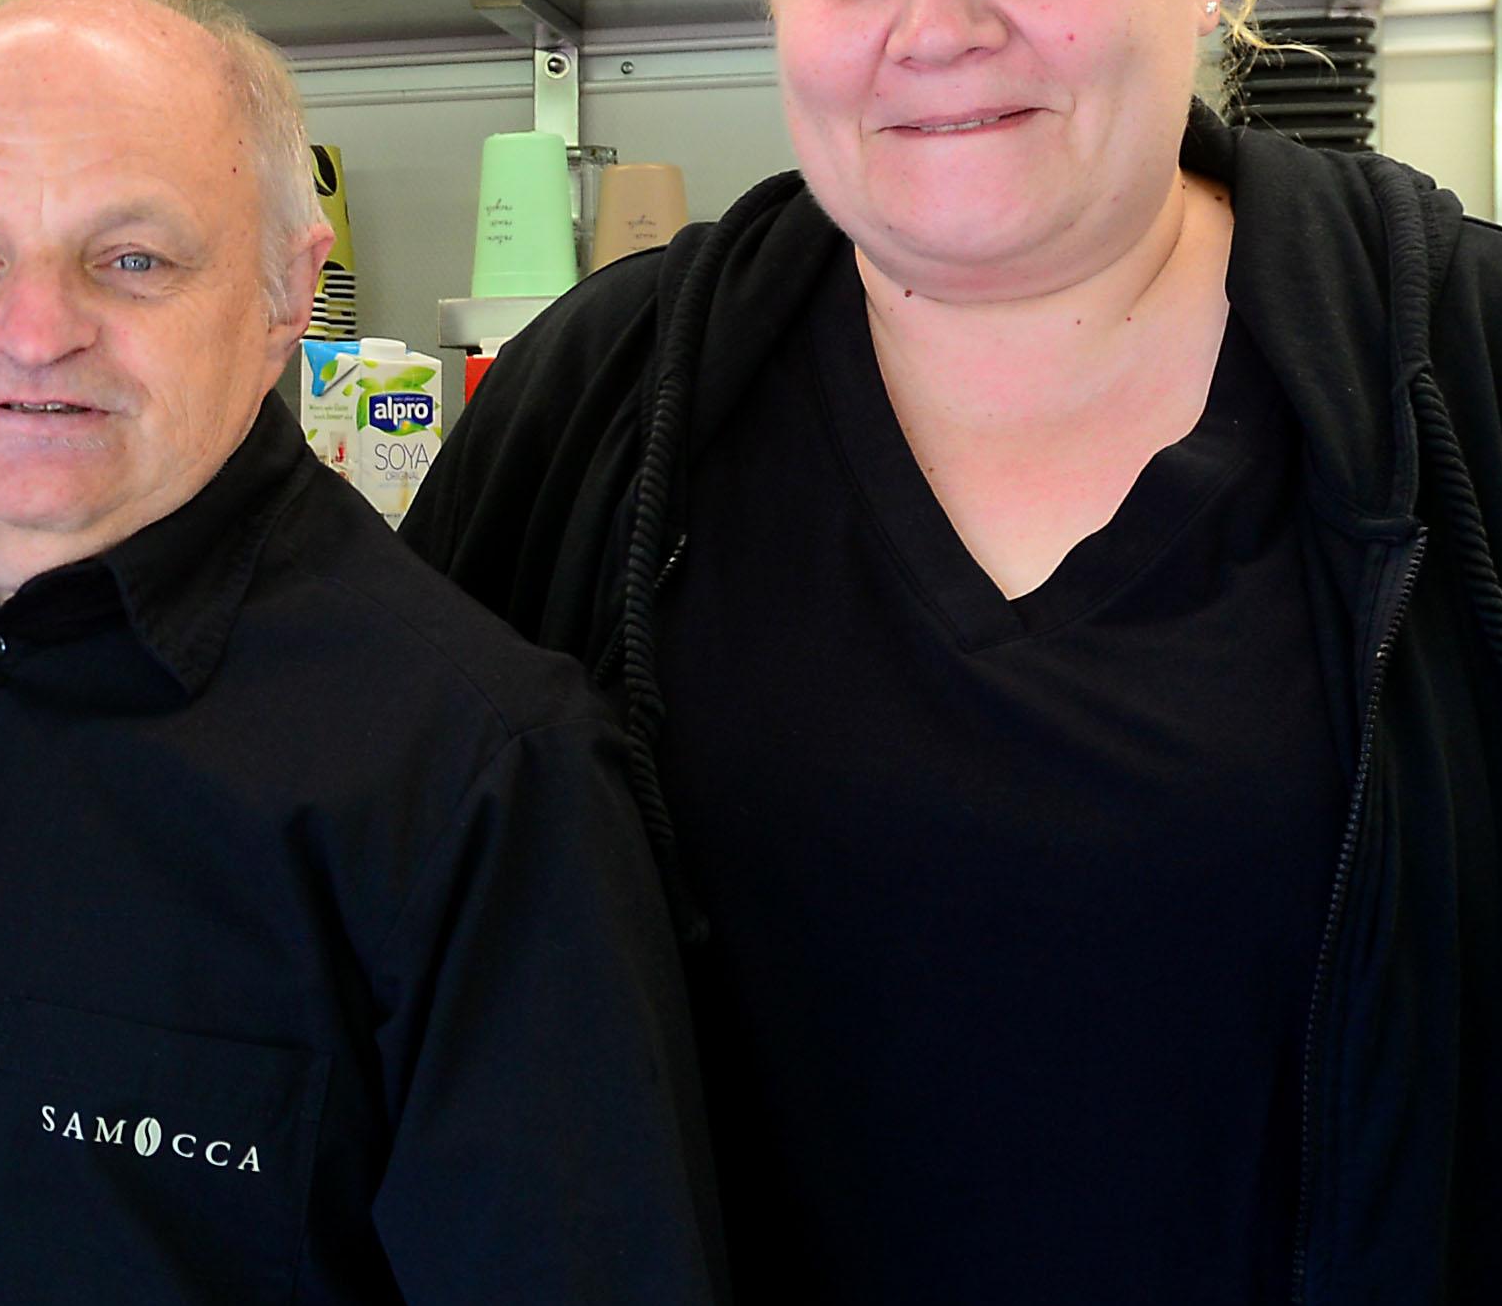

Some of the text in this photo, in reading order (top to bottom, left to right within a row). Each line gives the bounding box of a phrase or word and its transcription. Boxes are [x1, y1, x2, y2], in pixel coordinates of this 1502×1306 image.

[374, 396, 430, 426] alpro
[374, 442, 431, 471] SOYA
[41, 1105, 262, 1173] SAMOCCA
